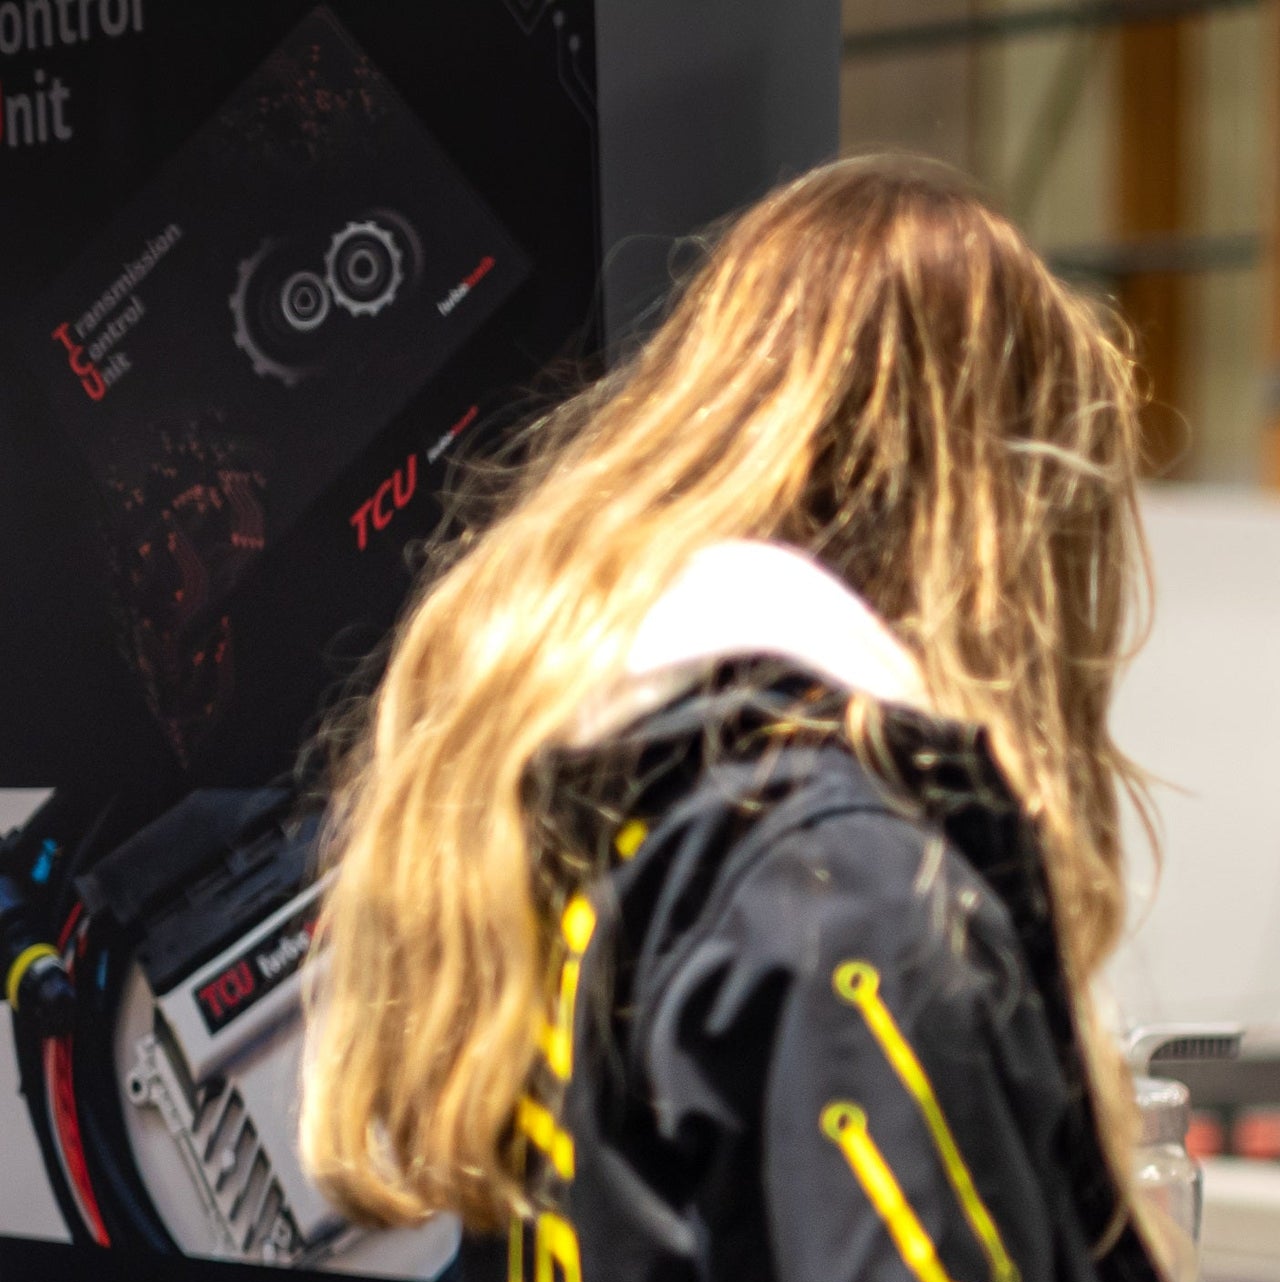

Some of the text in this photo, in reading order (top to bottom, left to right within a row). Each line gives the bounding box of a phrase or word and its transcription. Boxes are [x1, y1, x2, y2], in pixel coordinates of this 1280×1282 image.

[0, 68, 72, 147] nit
[350, 453, 417, 551] TCU
[200, 957, 255, 1018] TCU
